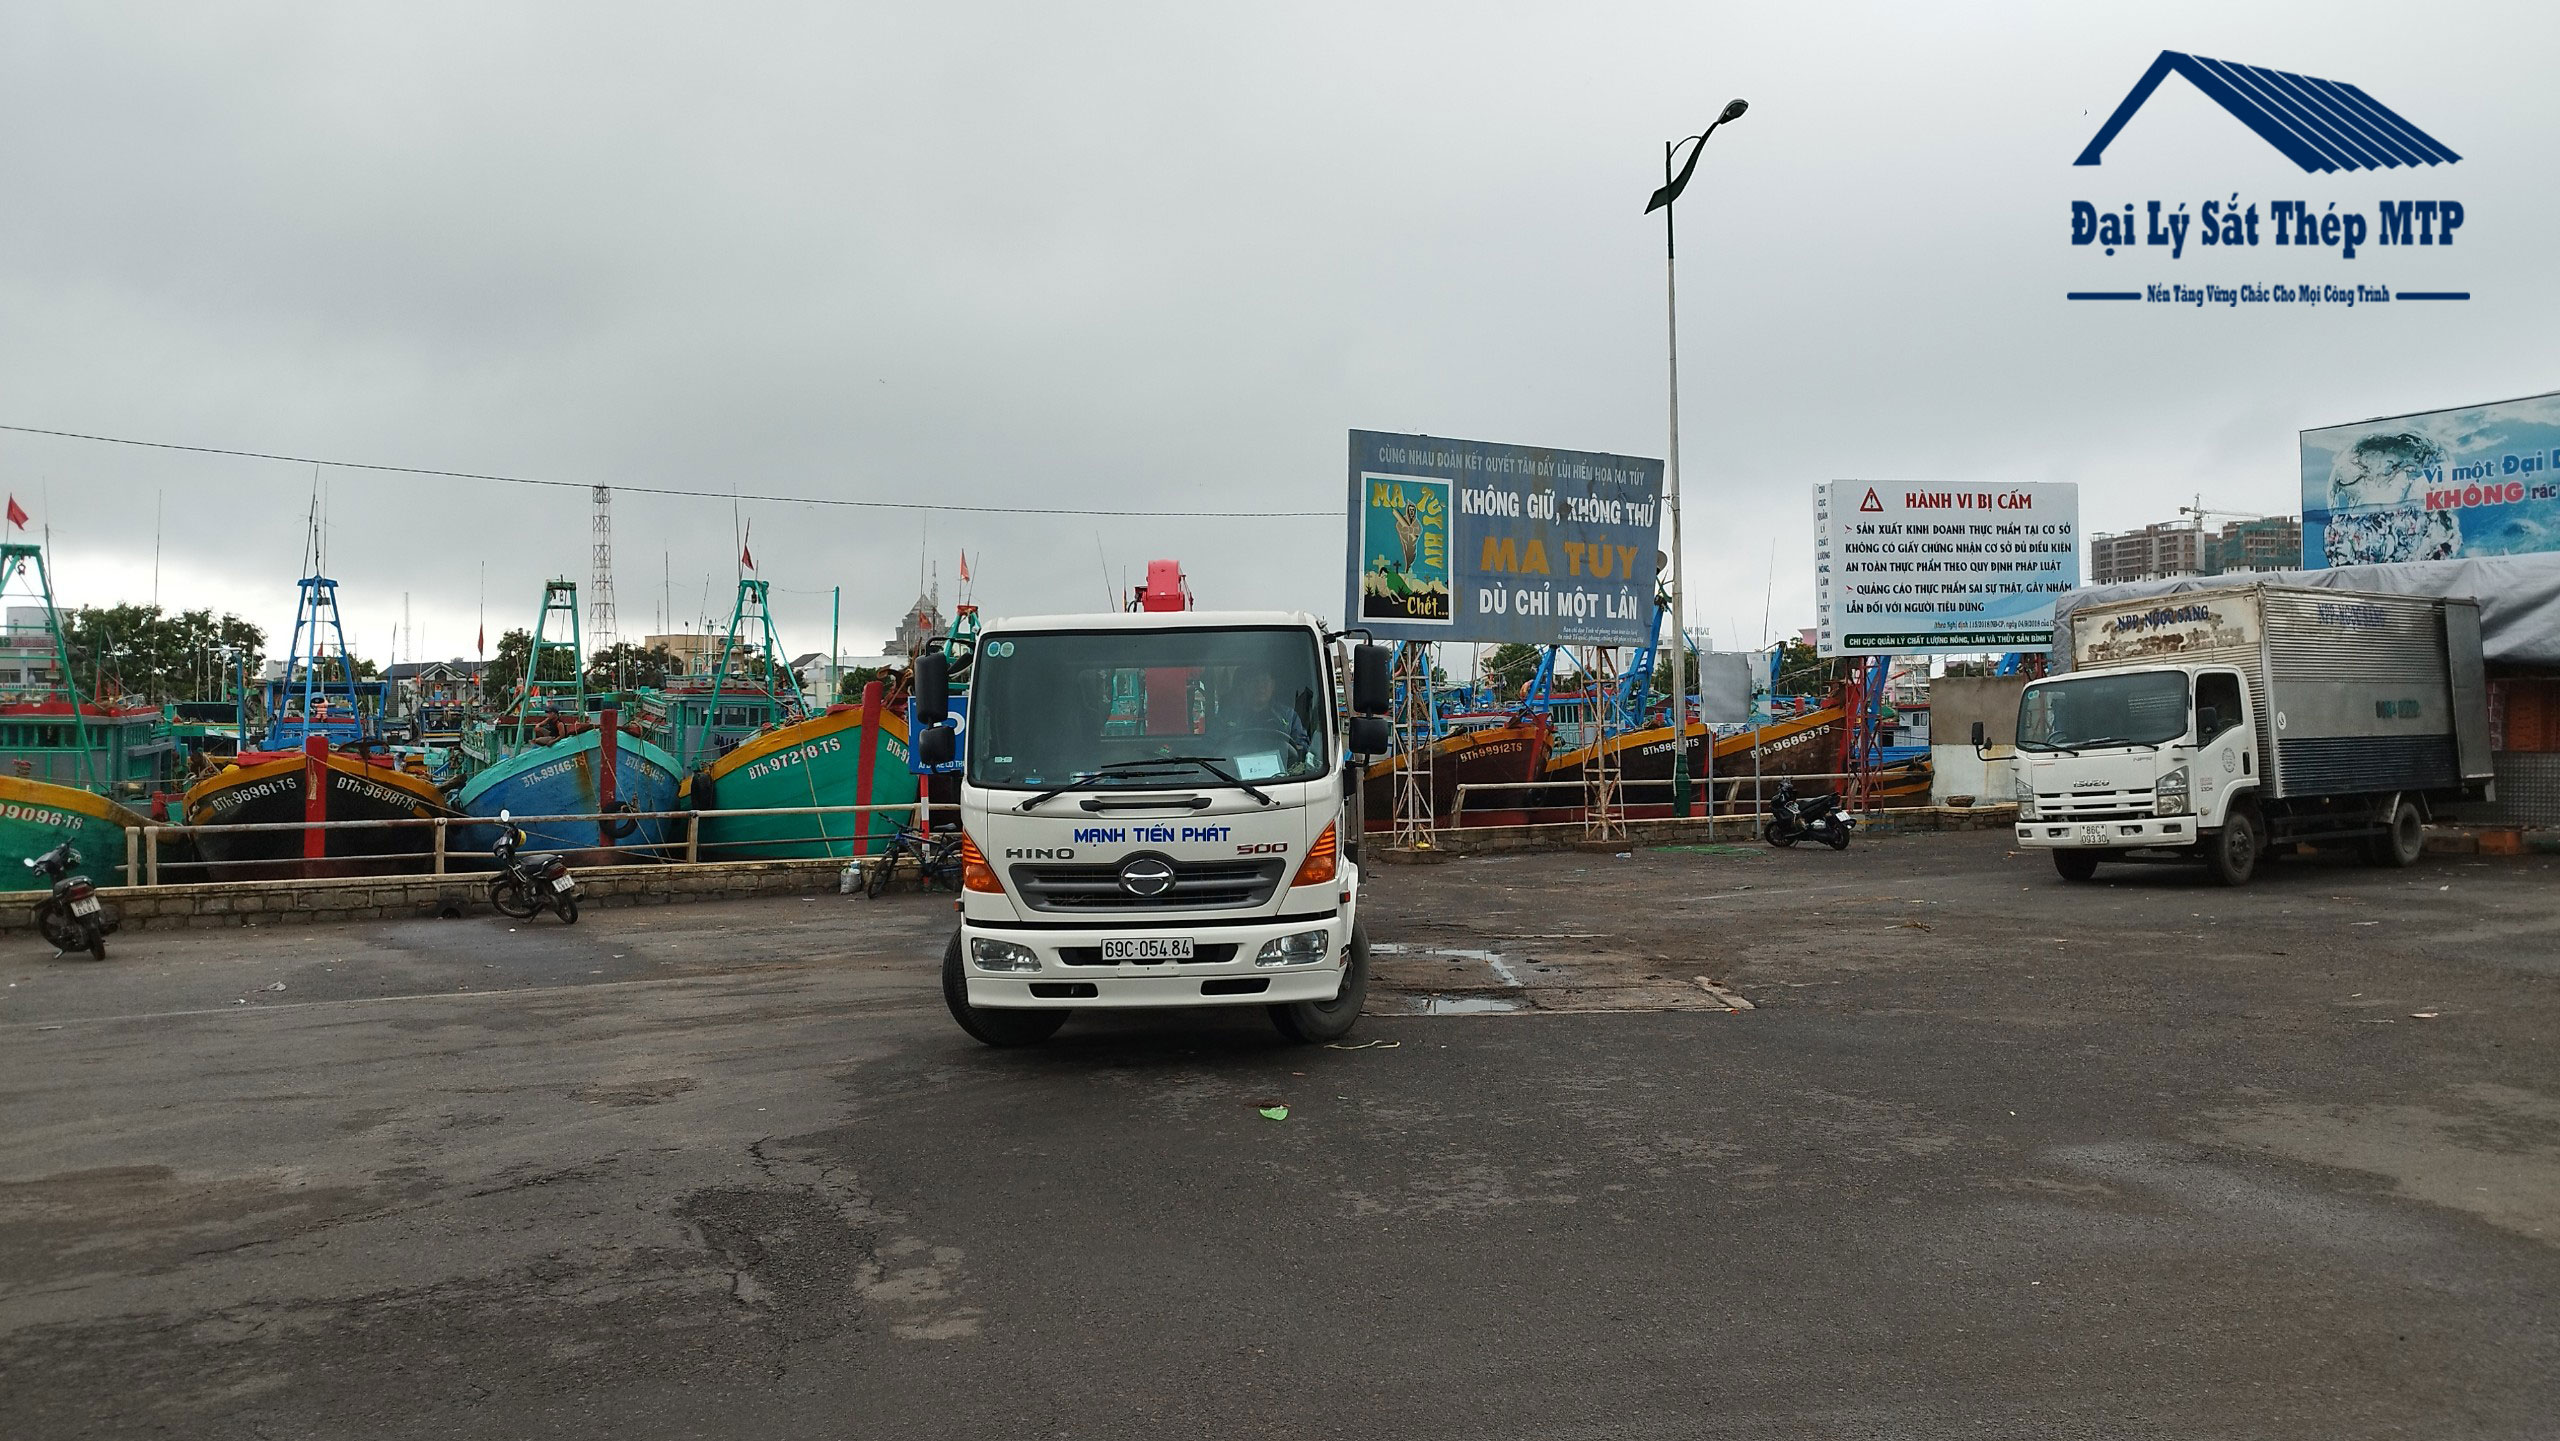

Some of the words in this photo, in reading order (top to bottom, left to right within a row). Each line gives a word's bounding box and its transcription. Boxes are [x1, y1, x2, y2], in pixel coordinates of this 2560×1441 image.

[1379, 444, 1406, 463] CÙNG
[1408, 450, 1434, 467] NHAU
[1437, 450, 1462, 469] ĐOÀN
[1464, 450, 1482, 470] KẾT
[1485, 453, 1515, 473] QUYẾT
[1518, 456, 1535, 475] TÂM
[1557, 460, 1571, 479] LÙI
[1629, 468, 1645, 485] TÚY
[2423, 465, 2443, 484] Vì
[2452, 461, 2494, 483] một
[2502, 451, 2543, 477] Đại
[1461, 484, 1520, 518] KHÔNG
[1527, 489, 1560, 526] GIỮ,
[1567, 494, 1621, 525] KHÔNG
[1626, 494, 1655, 527] THỬ
[1906, 489, 1951, 508] HÀNH
[1957, 494, 1972, 508] VI
[1978, 494, 1992, 512] BỊ
[1997, 489, 2032, 509] CẤM
[2426, 483, 2524, 511] KHÔNG
[2531, 484, 2557, 499] rác
[1371, 483, 1406, 508] MA
[1424, 532, 1444, 569] HIV
[1856, 522, 1874, 534] SẢN
[1879, 522, 1902, 534] XUẤT
[1906, 525, 1929, 534] KINH
[1933, 525, 1965, 534] DOANH
[1969, 525, 1992, 536] THỰC
[1996, 522, 2020, 534] PHẨM
[2025, 525, 2038, 536] TẠI
[2043, 525, 2055, 534] CƠ
[2059, 522, 2071, 534] SỞ
[1846, 541, 1879, 553] KHÔNG
[1882, 542, 1895, 553] CÓ
[1898, 541, 1918, 553] GIẤY
[1922, 542, 1953, 553] CHỨNG
[1956, 542, 1982, 555] NHẬN
[1985, 543, 1997, 553] CƠ
[2000, 541, 2012, 552] SỞ
[2015, 541, 2026, 552] ĐỦ
[2051, 542, 2071, 554] KIỆN
[1480, 536, 1551, 575] MA
[1564, 534, 1639, 580] TÚY
[1846, 563, 1858, 571] AN
[1861, 561, 1887, 571] TOÀN
[1890, 562, 1913, 573] THỰC
[1917, 558, 1941, 571] PHẨM
[1944, 562, 1967, 571] THEO
[1970, 562, 1988, 572] QUY
[1991, 562, 2012, 573] ĐỊNH
[2016, 560, 2038, 571] PHÁP
[2041, 560, 2061, 572] LUẬT
[1857, 582, 1890, 595] QUẢNG
[1893, 583, 1912, 593] CÁO
[1915, 584, 1938, 595] THỰC
[1942, 581, 1966, 593] PHẨM
[1969, 584, 1982, 593] SAI
[1986, 584, 1996, 595] SỰ
[1479, 582, 1507, 615] DÙ
[1515, 581, 1550, 617] CHỈ
[1557, 586, 1599, 624] MỘT
[1606, 585, 1638, 619] LẦN
[1867, 601, 1882, 613] ĐỐI
[1885, 601, 1901, 612] VỚI
[1905, 601, 1934, 612] NGƯỜI
[1959, 600, 1984, 611] DÙNG
[1849, 638, 1860, 646] CHI
[1862, 638, 1876, 647] CỤC
[1877, 635, 1895, 645] QUẢN
[1897, 635, 1905, 645] LÝ
[1907, 635, 1924, 644] CHẤT
[1926, 636, 1948, 646] LƯỢNG
[1971, 635, 1986, 643] LÂM
[1987, 635, 1996, 643] VÀ
[2017, 633, 2030, 642] SẢN
[2031, 634, 2047, 642] BÌNH
[2073, 780, 2110, 788] ISUZU
[212, 777, 297, 811] BTh-96981-TS
[1074, 828, 1126, 847] MẠNH
[1133, 822, 1175, 842] TIẾN
[1182, 823, 1231, 842] PHÁT
[2086, 826, 2101, 835] 86C
[1006, 848, 1075, 859] HINO
[1237, 843, 1288, 855] 500
[1105, 940, 1190, 957] 69C-054.84
